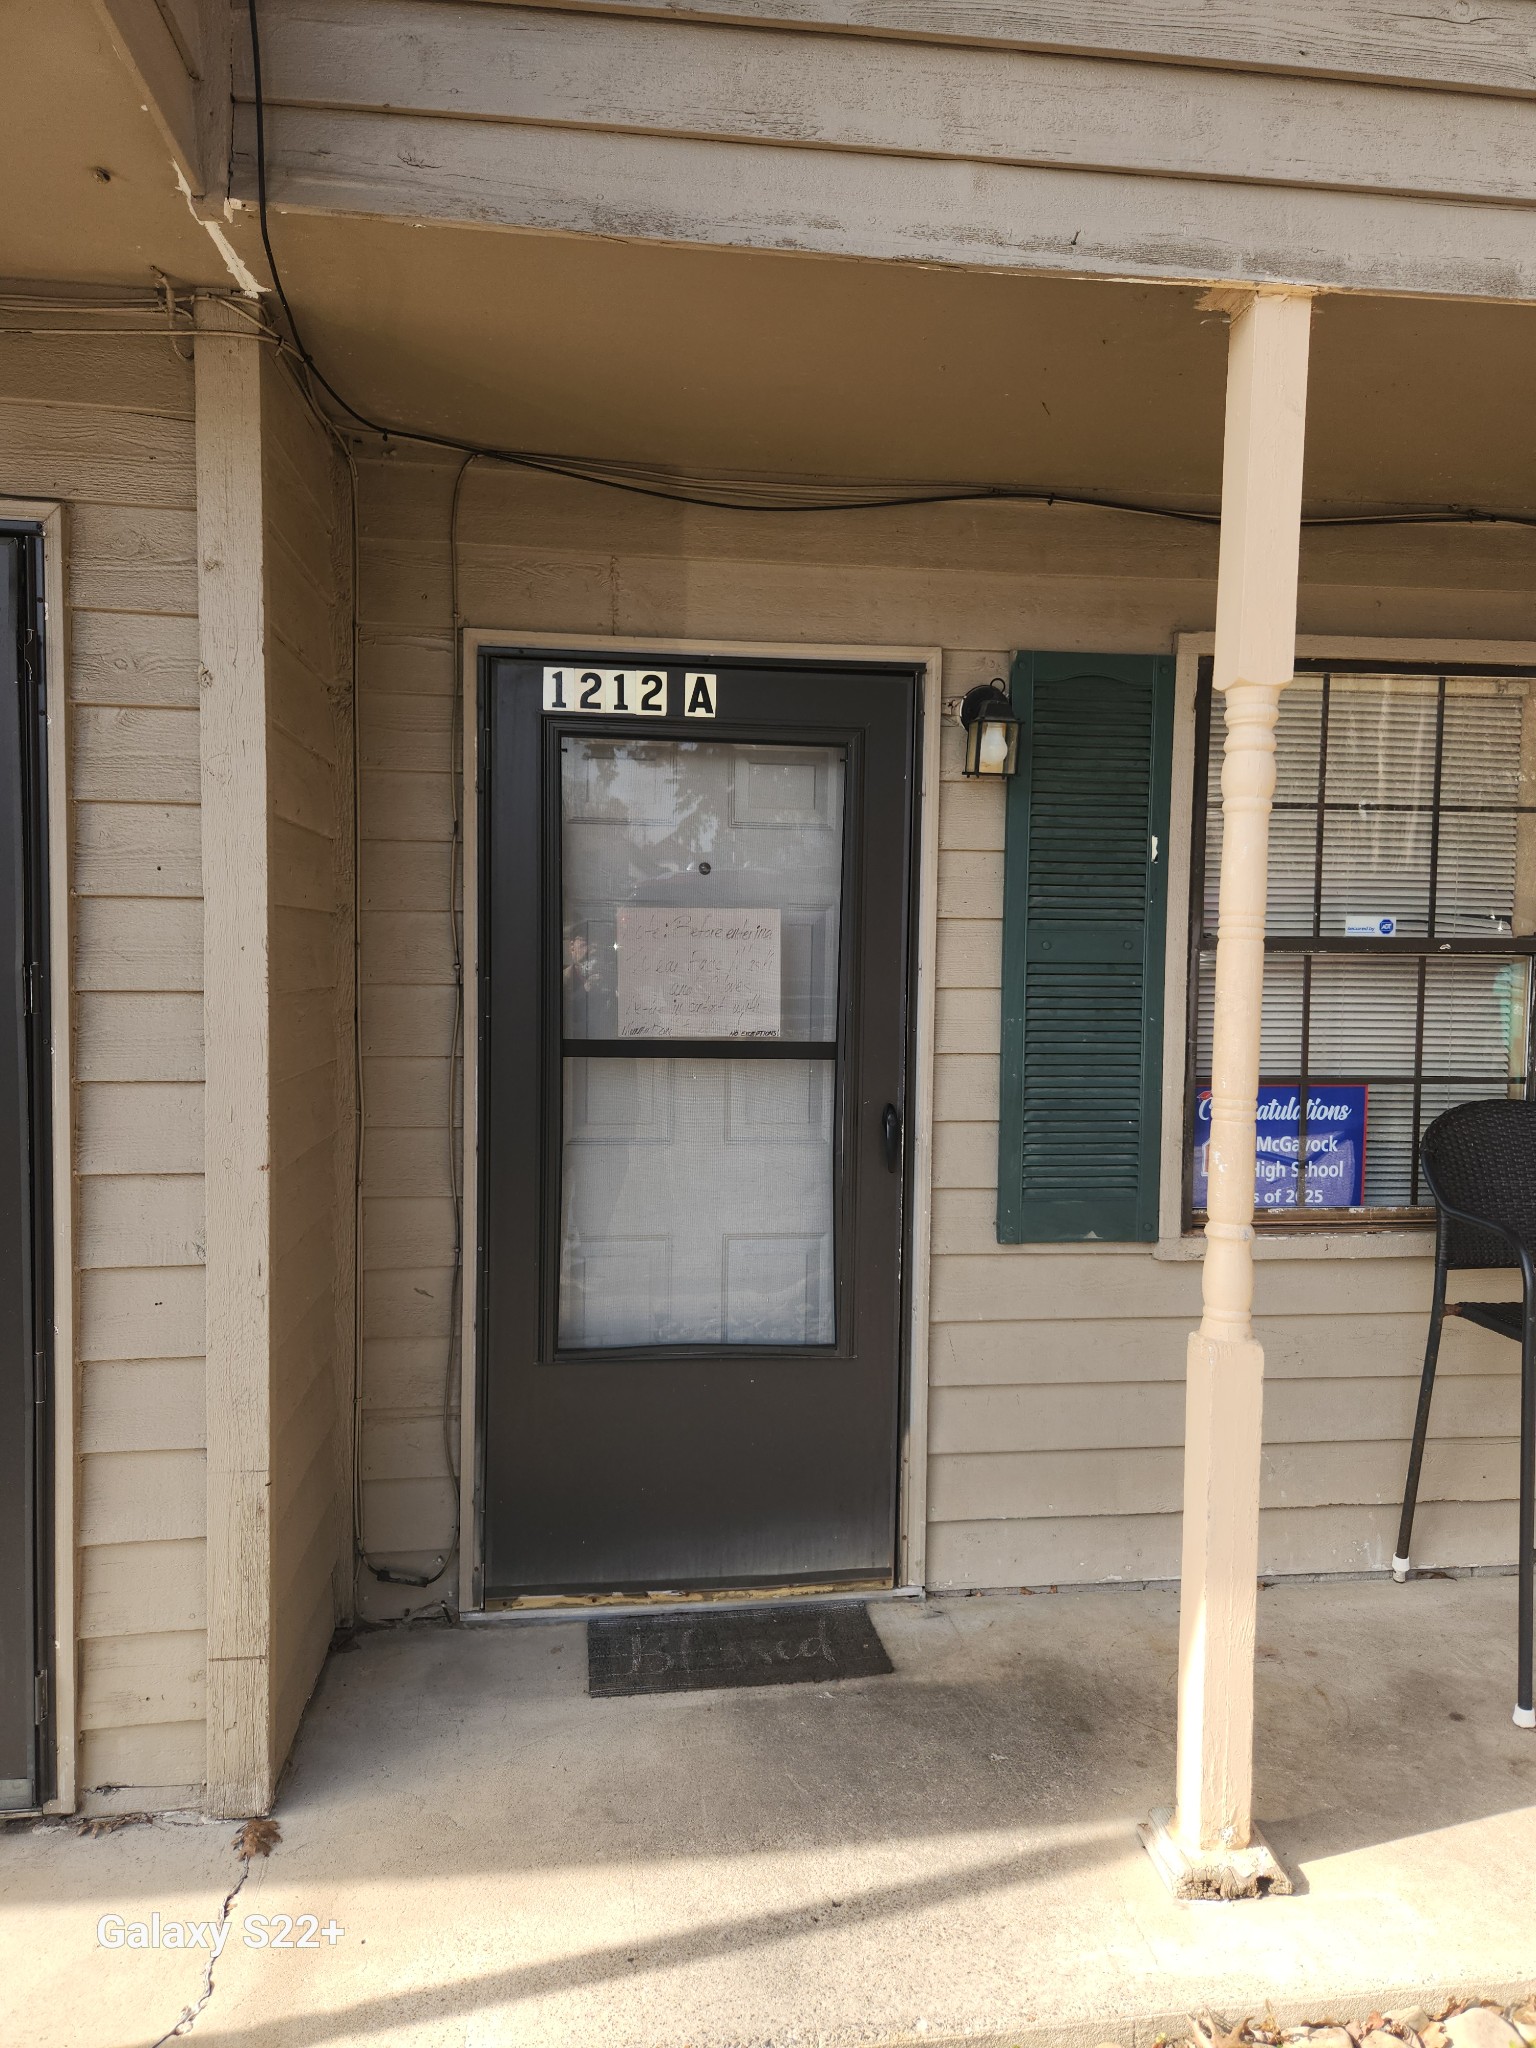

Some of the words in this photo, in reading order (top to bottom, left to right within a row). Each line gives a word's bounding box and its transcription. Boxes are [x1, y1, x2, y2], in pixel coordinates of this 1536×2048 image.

[552, 671, 663, 711] 1212
[688, 676, 714, 713] A
[1199, 1097, 1352, 1121] Catulations
[1291, 1161, 1343, 1178] Shool
[1264, 1189, 1282, 1203] of
